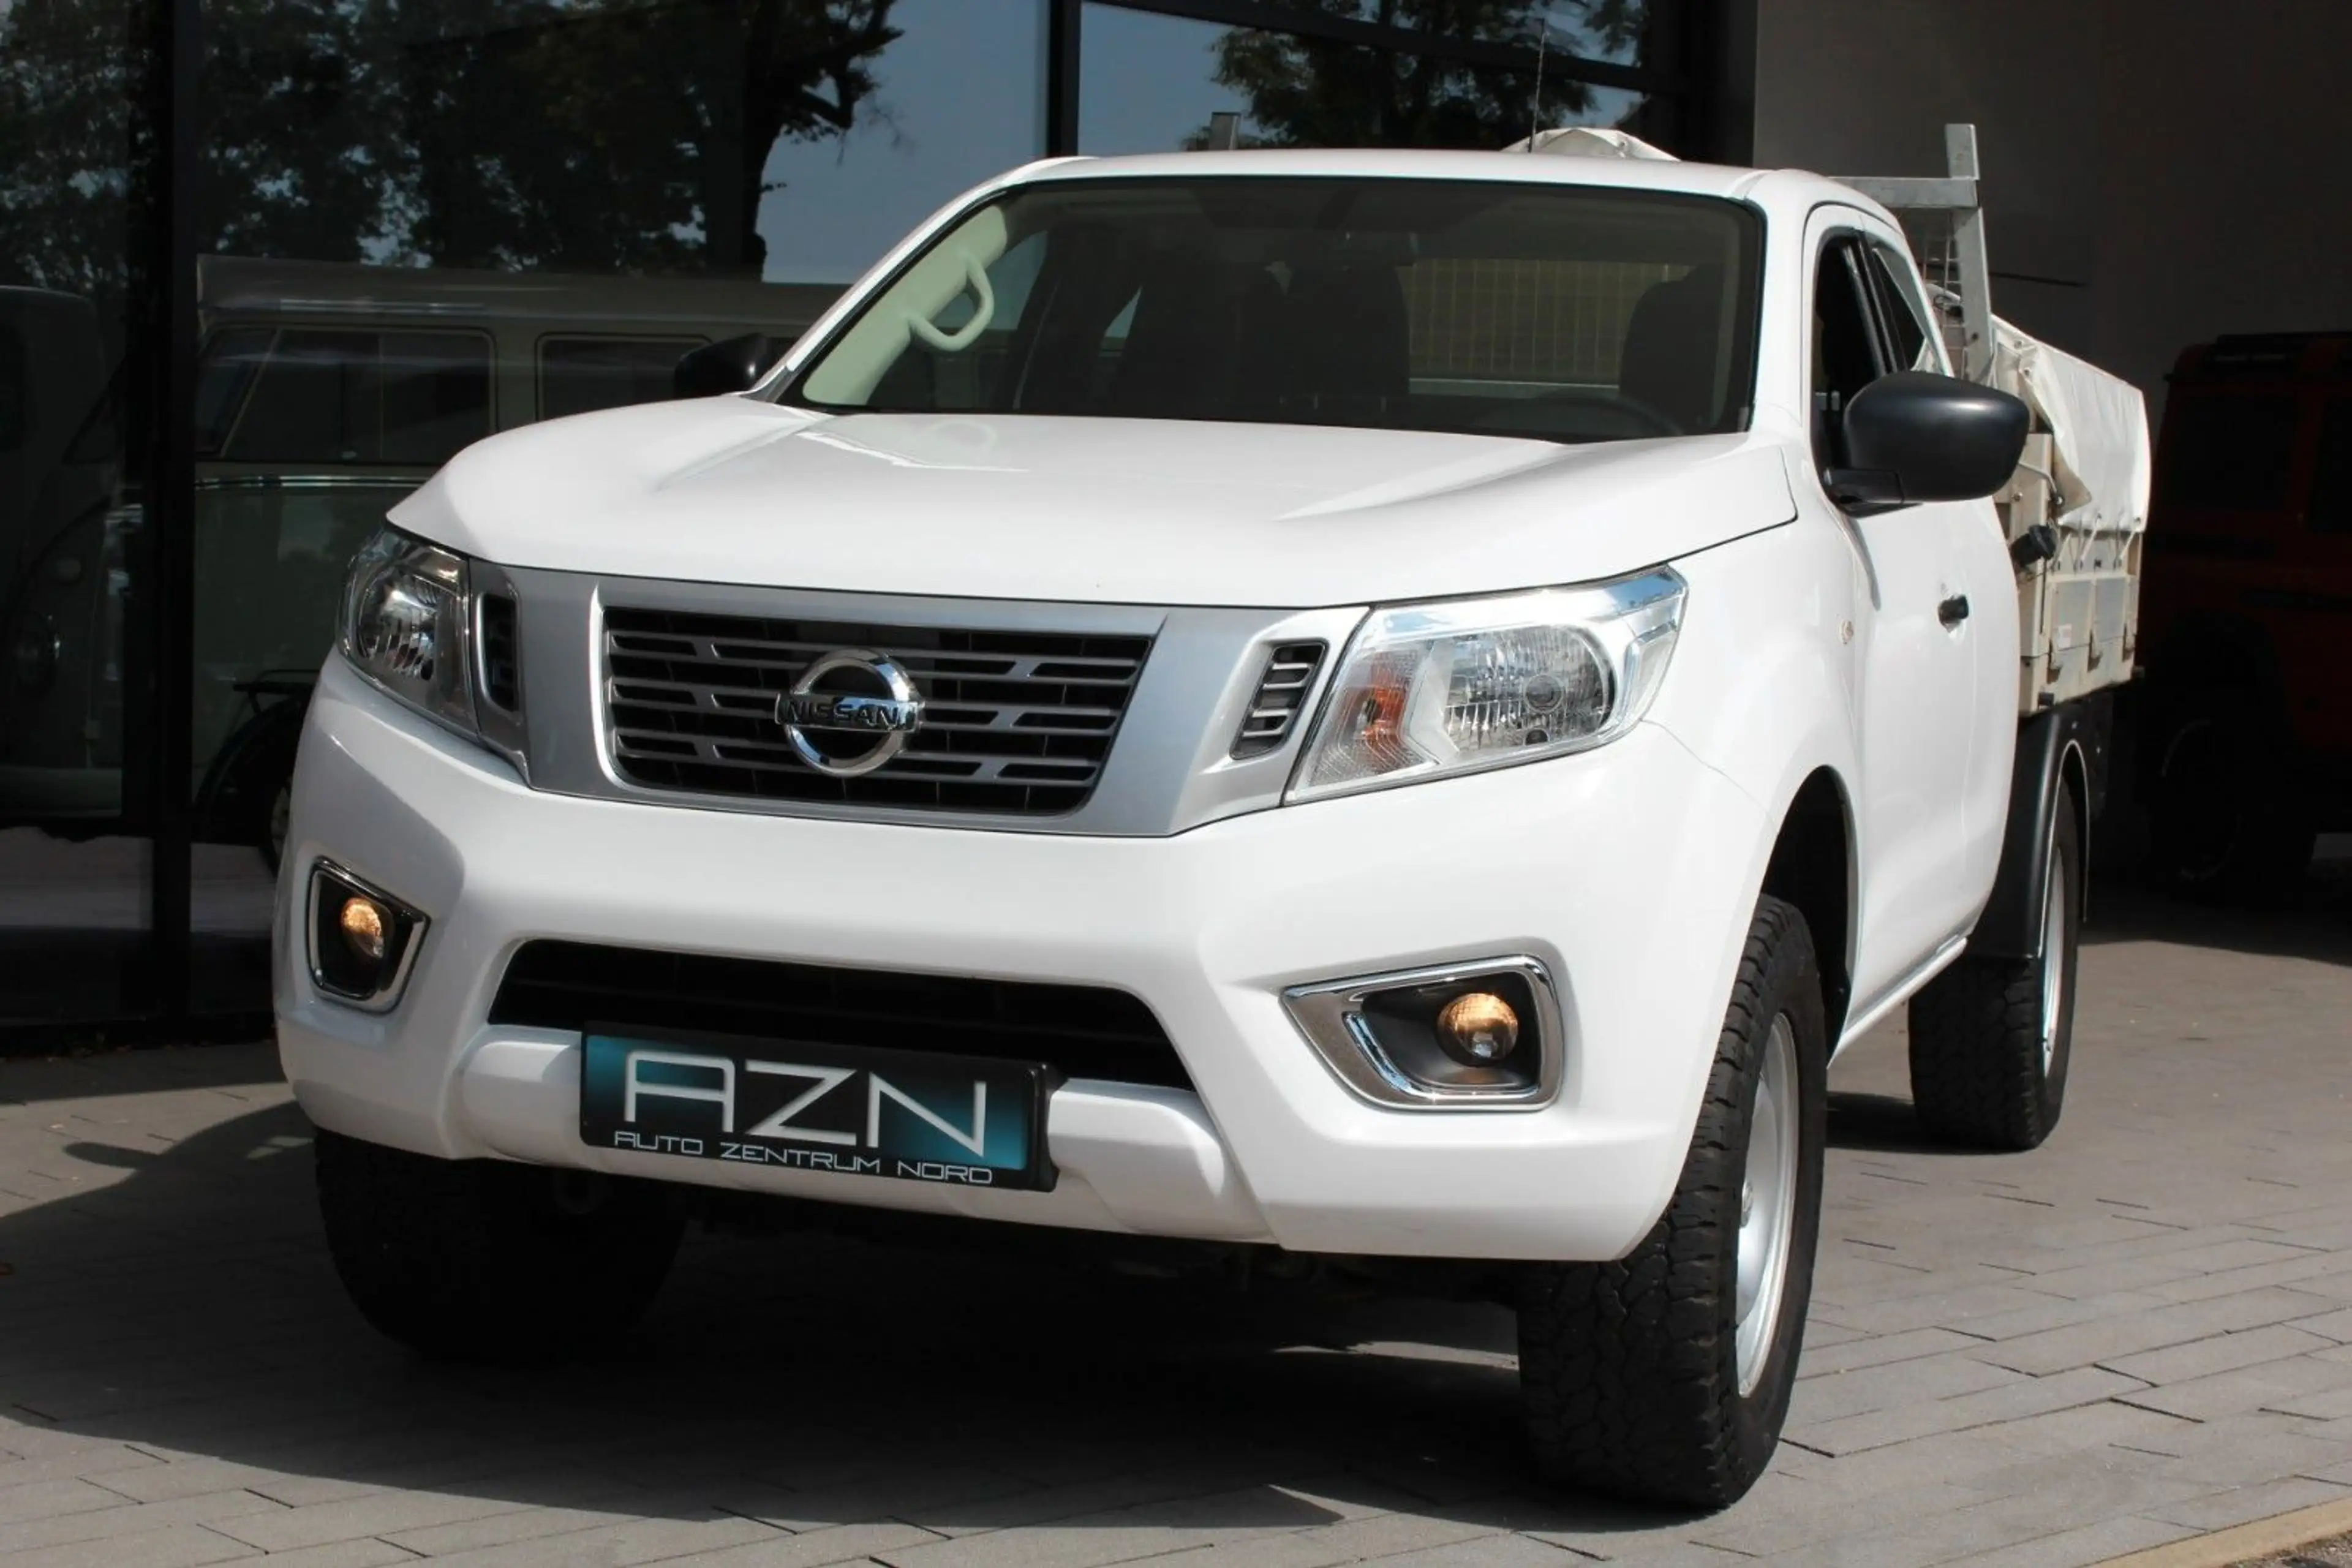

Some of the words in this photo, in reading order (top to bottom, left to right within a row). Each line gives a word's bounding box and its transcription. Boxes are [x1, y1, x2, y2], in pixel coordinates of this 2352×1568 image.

[783, 699, 900, 728] NISSAN
[624, 1050, 986, 1157] AZN
[615, 1131, 703, 1155] AUTO
[720, 1142, 880, 1174] ZENTRUM
[897, 1160, 992, 1185] NORD
